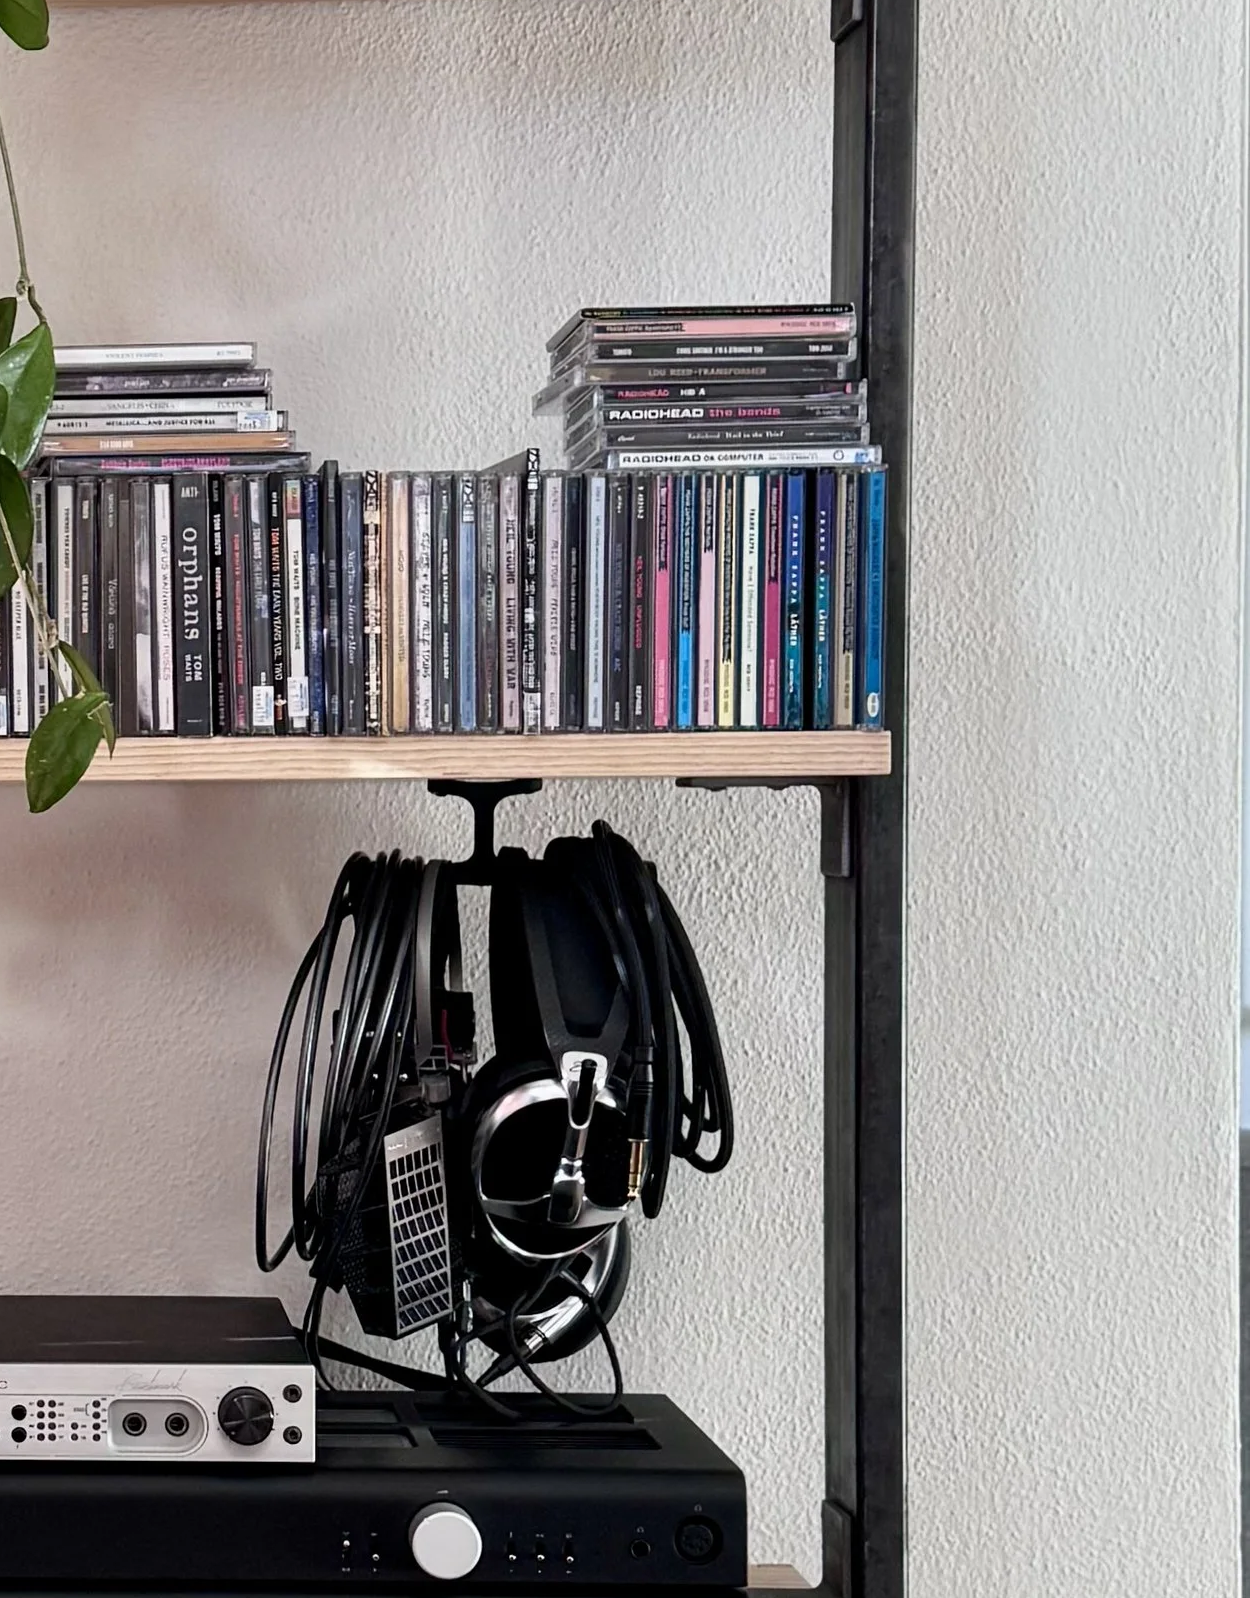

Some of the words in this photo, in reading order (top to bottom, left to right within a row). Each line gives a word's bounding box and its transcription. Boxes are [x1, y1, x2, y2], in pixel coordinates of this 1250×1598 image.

[609, 408, 704, 420] RADIOHEAD
[709, 408, 733, 418] the
[738, 407, 781, 417] bends
[622, 454, 701, 463] RADIOHEAD
[718, 452, 764, 462] COMPUTER
[178, 527, 203, 640] orphans
[506, 598, 516, 632] LIVING
[506, 638, 516, 662] WITH
[193, 654, 202, 681] TOM
[274, 662, 283, 681] TWO
[506, 668, 516, 689] WAR
